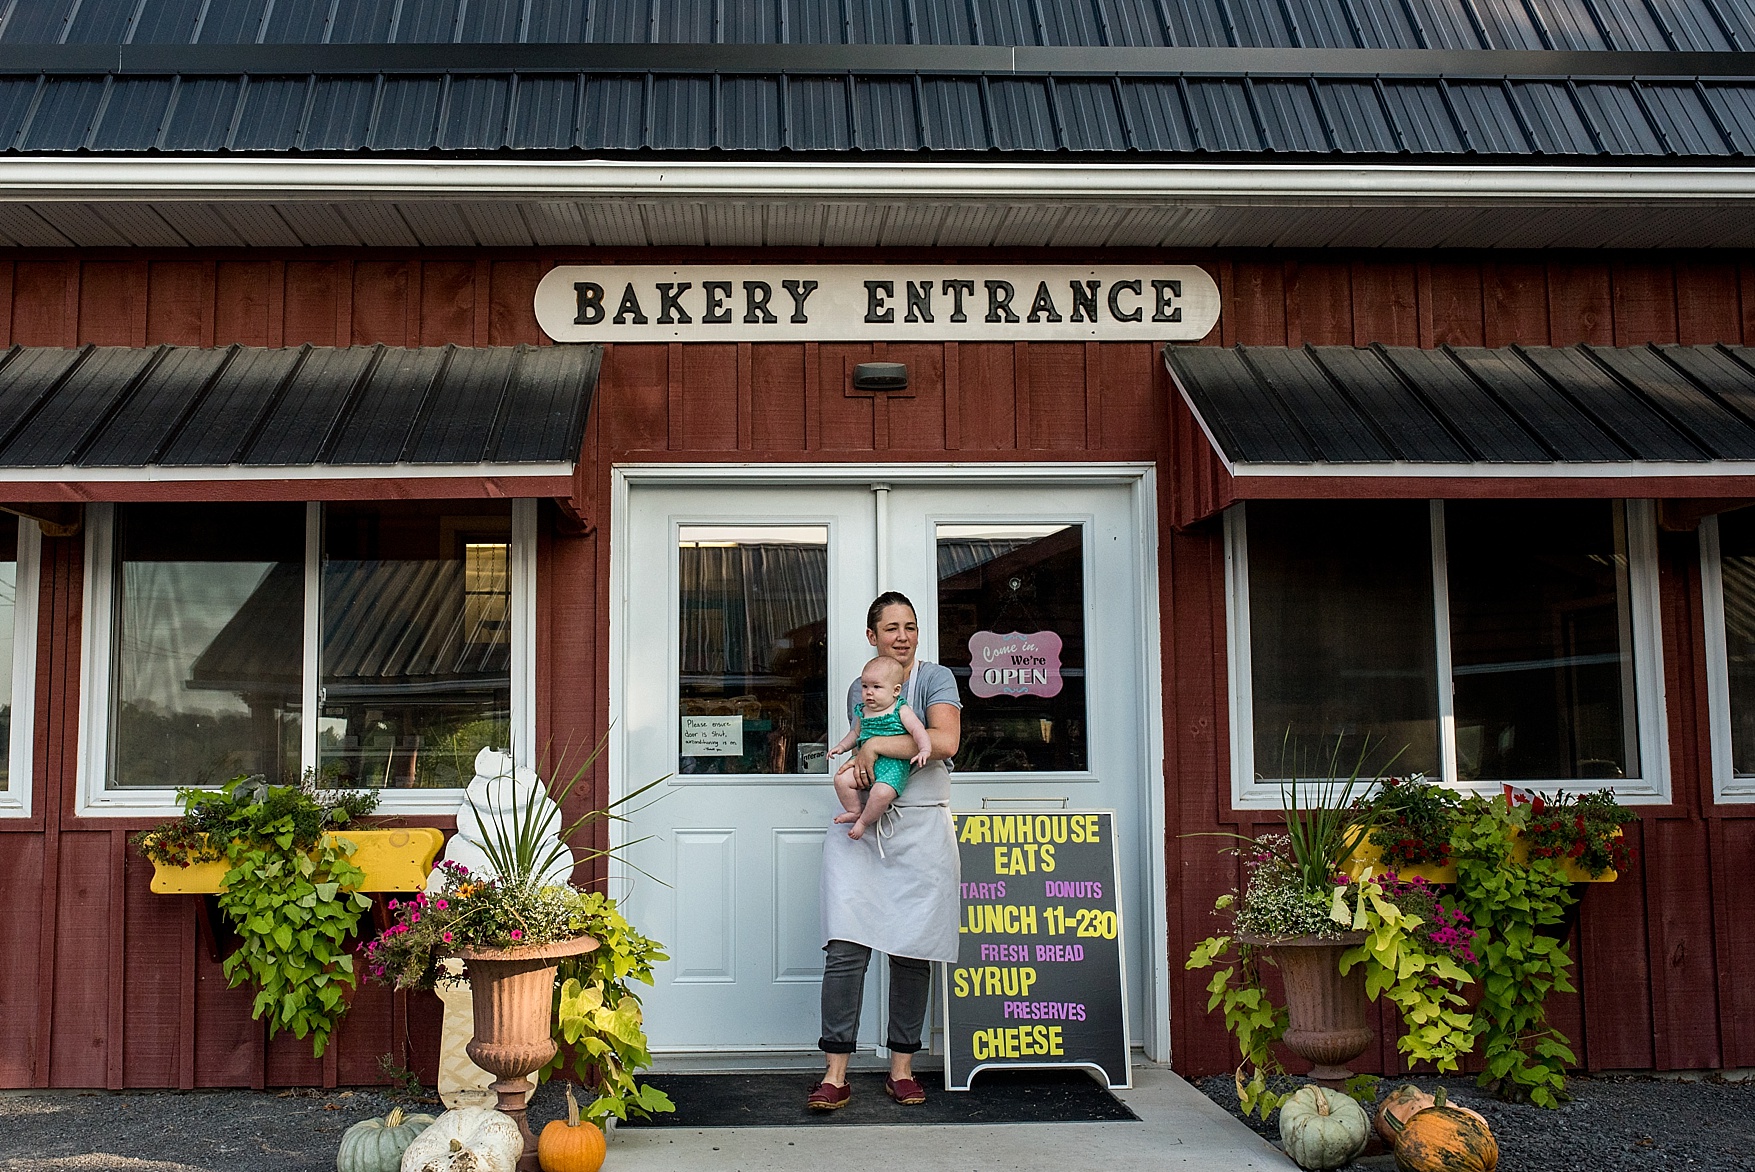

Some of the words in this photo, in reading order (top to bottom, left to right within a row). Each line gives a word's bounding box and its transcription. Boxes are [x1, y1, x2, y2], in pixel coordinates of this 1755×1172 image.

[573, 279, 818, 326] BAKERY
[863, 279, 1183, 325] ENTRANCE
[983, 644, 1017, 663] Come
[1011, 655, 1046, 665] We're
[983, 668, 1047, 685] OPEN
[686, 719, 708, 728] Please
[684, 729, 698, 738] door
[802, 751, 825, 761] Interac
[994, 844, 1056, 876] EATS
[960, 881, 1006, 899] TARTS
[1045, 881, 1103, 899] DONUTS
[1043, 905, 1118, 940] 11-230
[980, 944, 1029, 962] FRESH
[1036, 944, 1085, 962] BREAD
[953, 966, 1037, 998] SYRUP
[1004, 1001, 1087, 1022] PRESERVES
[972, 1024, 1064, 1061] CHEESE
